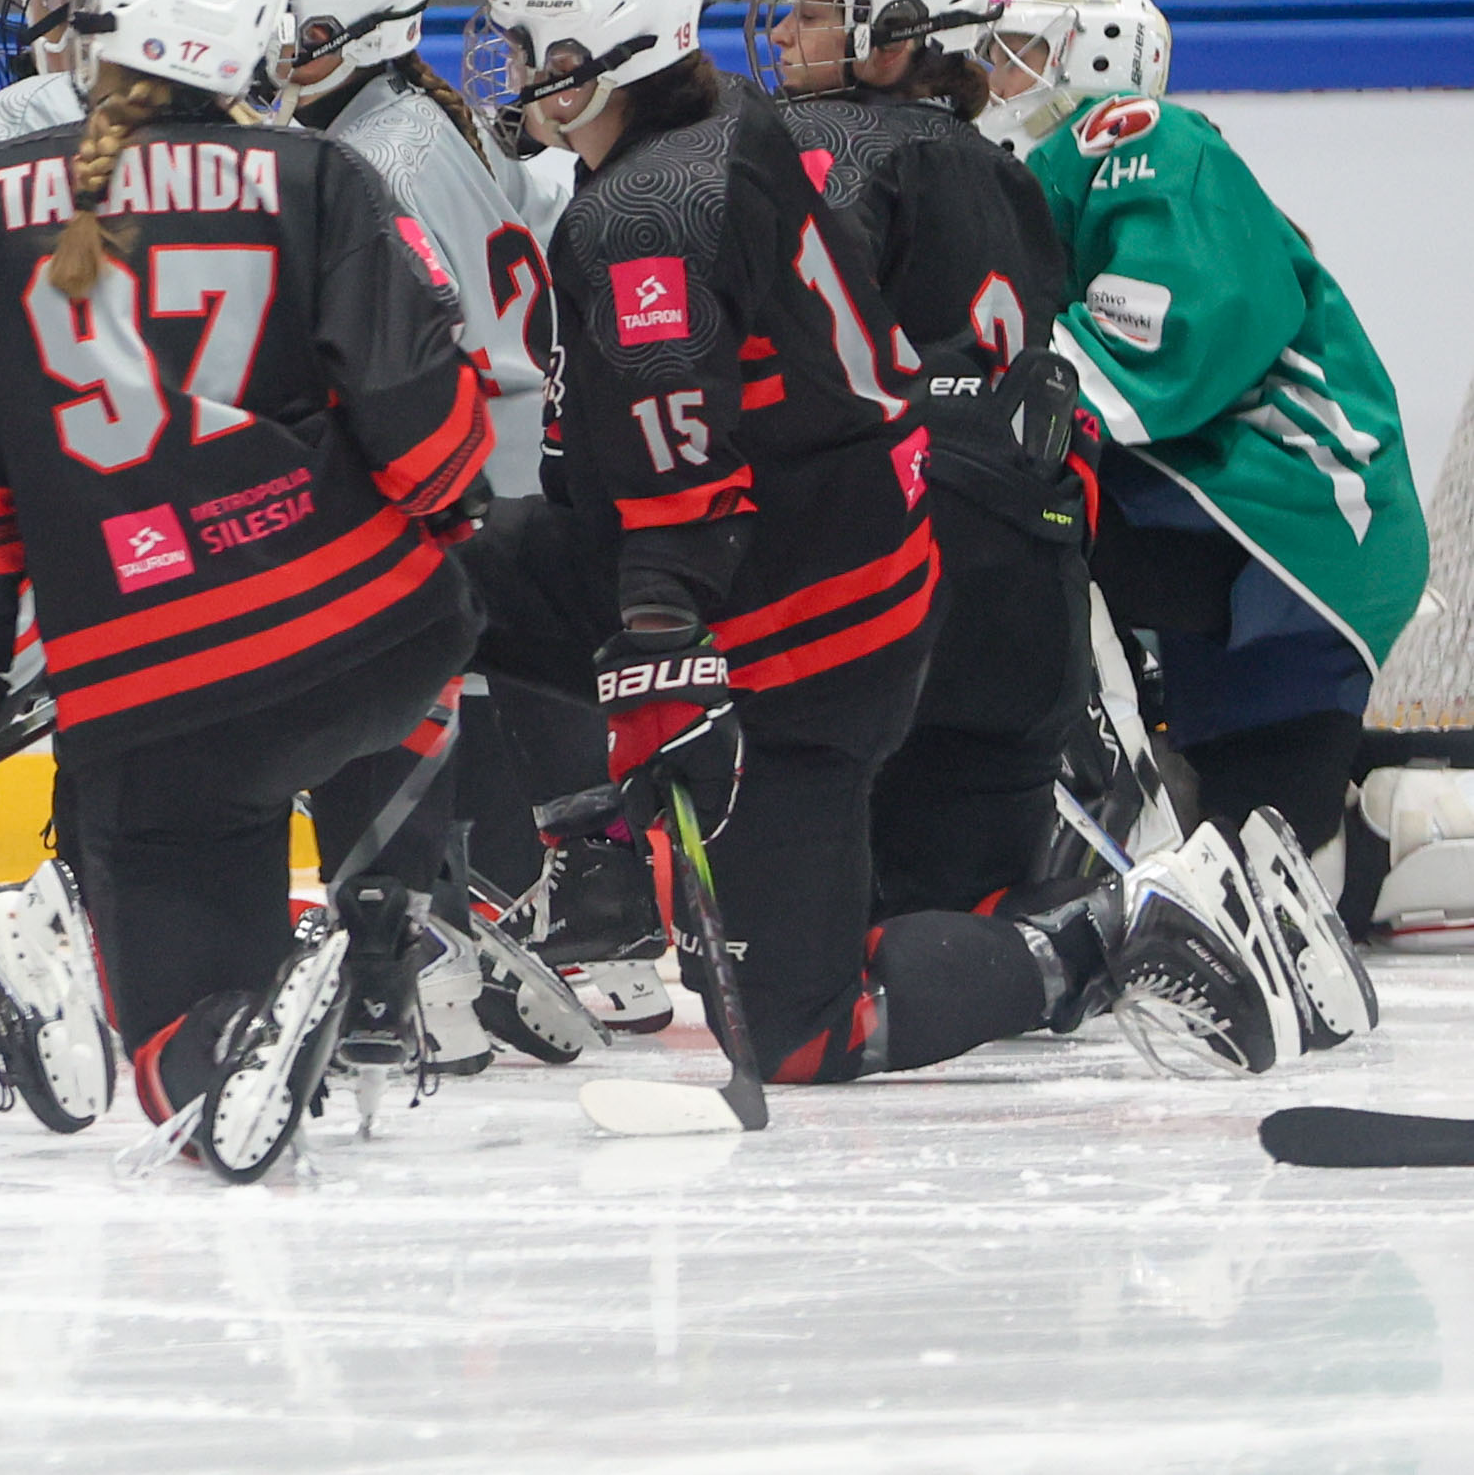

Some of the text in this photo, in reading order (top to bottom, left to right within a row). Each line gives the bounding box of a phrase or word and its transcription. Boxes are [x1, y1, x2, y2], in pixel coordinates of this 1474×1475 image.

[526, 0, 573, 9] BAUER
[181, 39, 210, 63] 17
[313, 32, 352, 59] BAUER
[674, 21, 691, 51] 19
[1130, 22, 1146, 86] BAUER
[620, 307, 683, 330] TAURON
[22, 243, 279, 475] 97
[631, 388, 710, 473] 15
[191, 466, 313, 521] METROPOLIA
[200, 490, 315, 556] SILESIA
[120, 549, 186, 579] TAURON
[596, 654, 730, 704] BAUER
